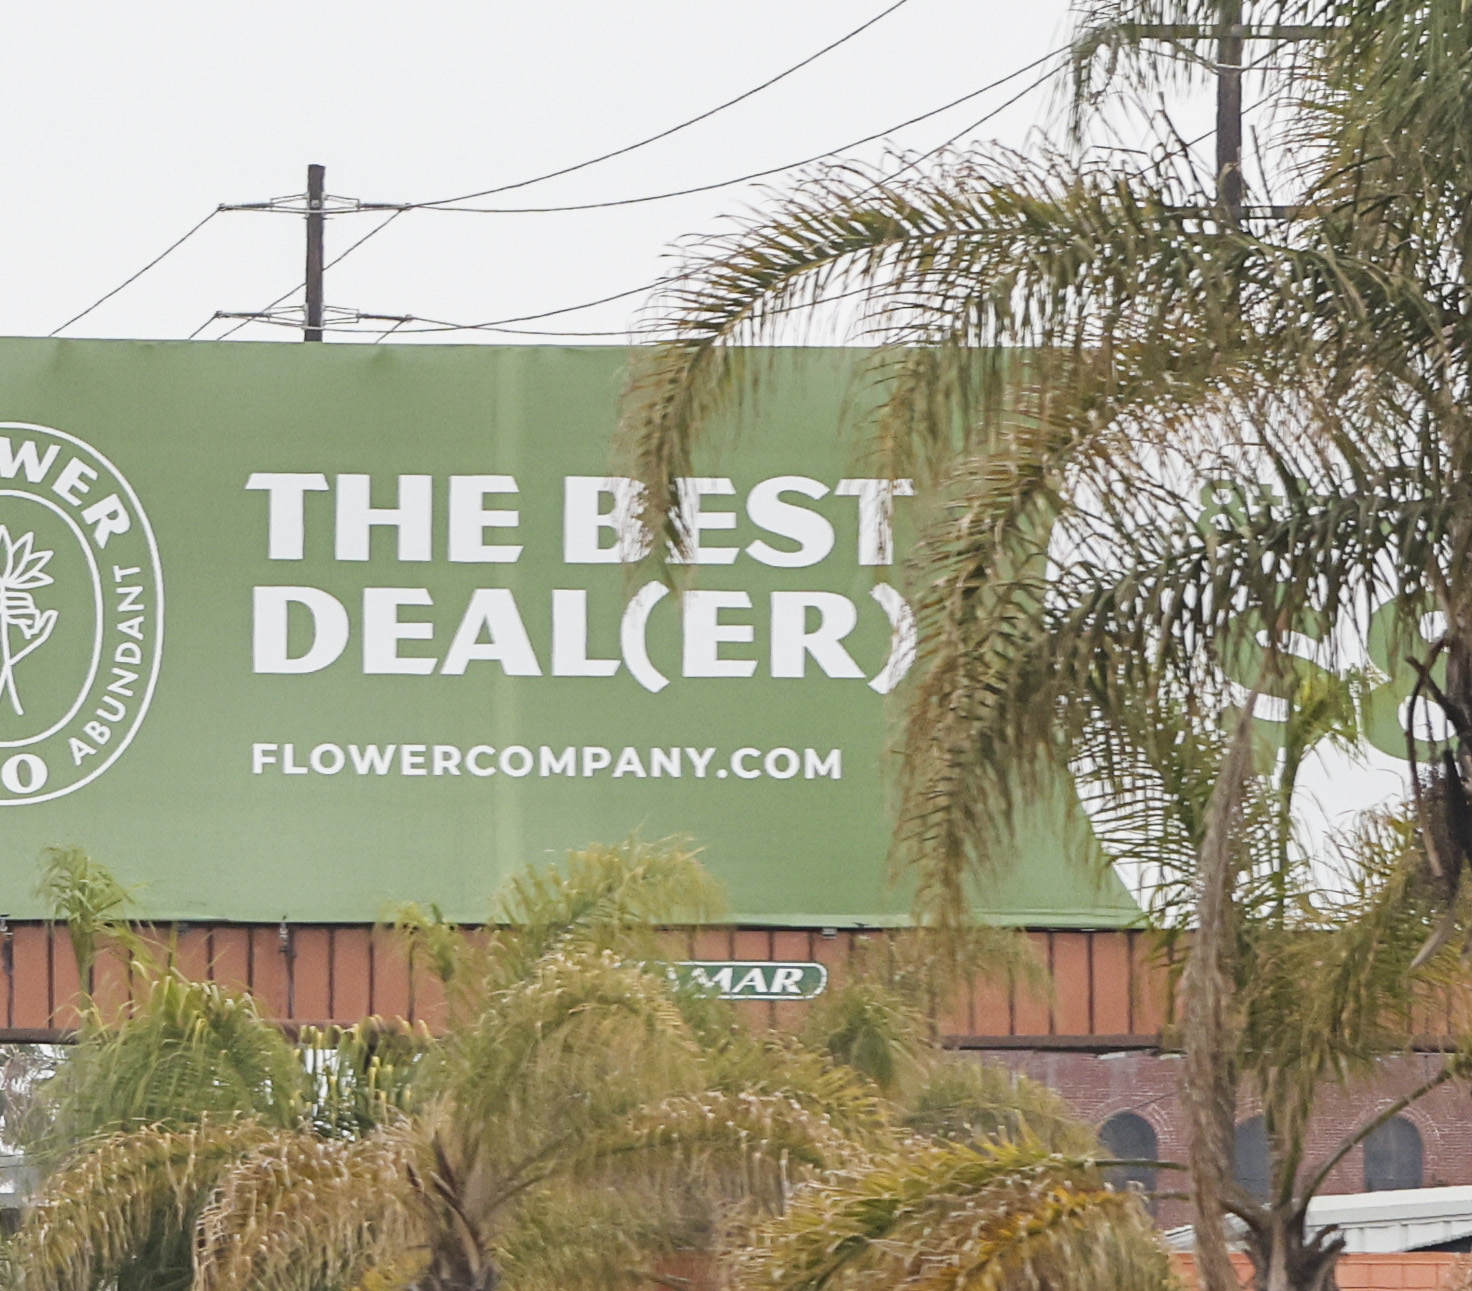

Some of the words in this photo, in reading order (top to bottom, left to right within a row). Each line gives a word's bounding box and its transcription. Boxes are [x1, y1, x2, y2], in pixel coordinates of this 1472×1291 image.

[245, 473, 523, 562] THE
[564, 474, 918, 568] BEST
[68, 565, 144, 766] ABUNDANT
[253, 581, 917, 694] DEAL(ER)
[253, 743, 840, 779] FLOWERCOMPANY.COM
